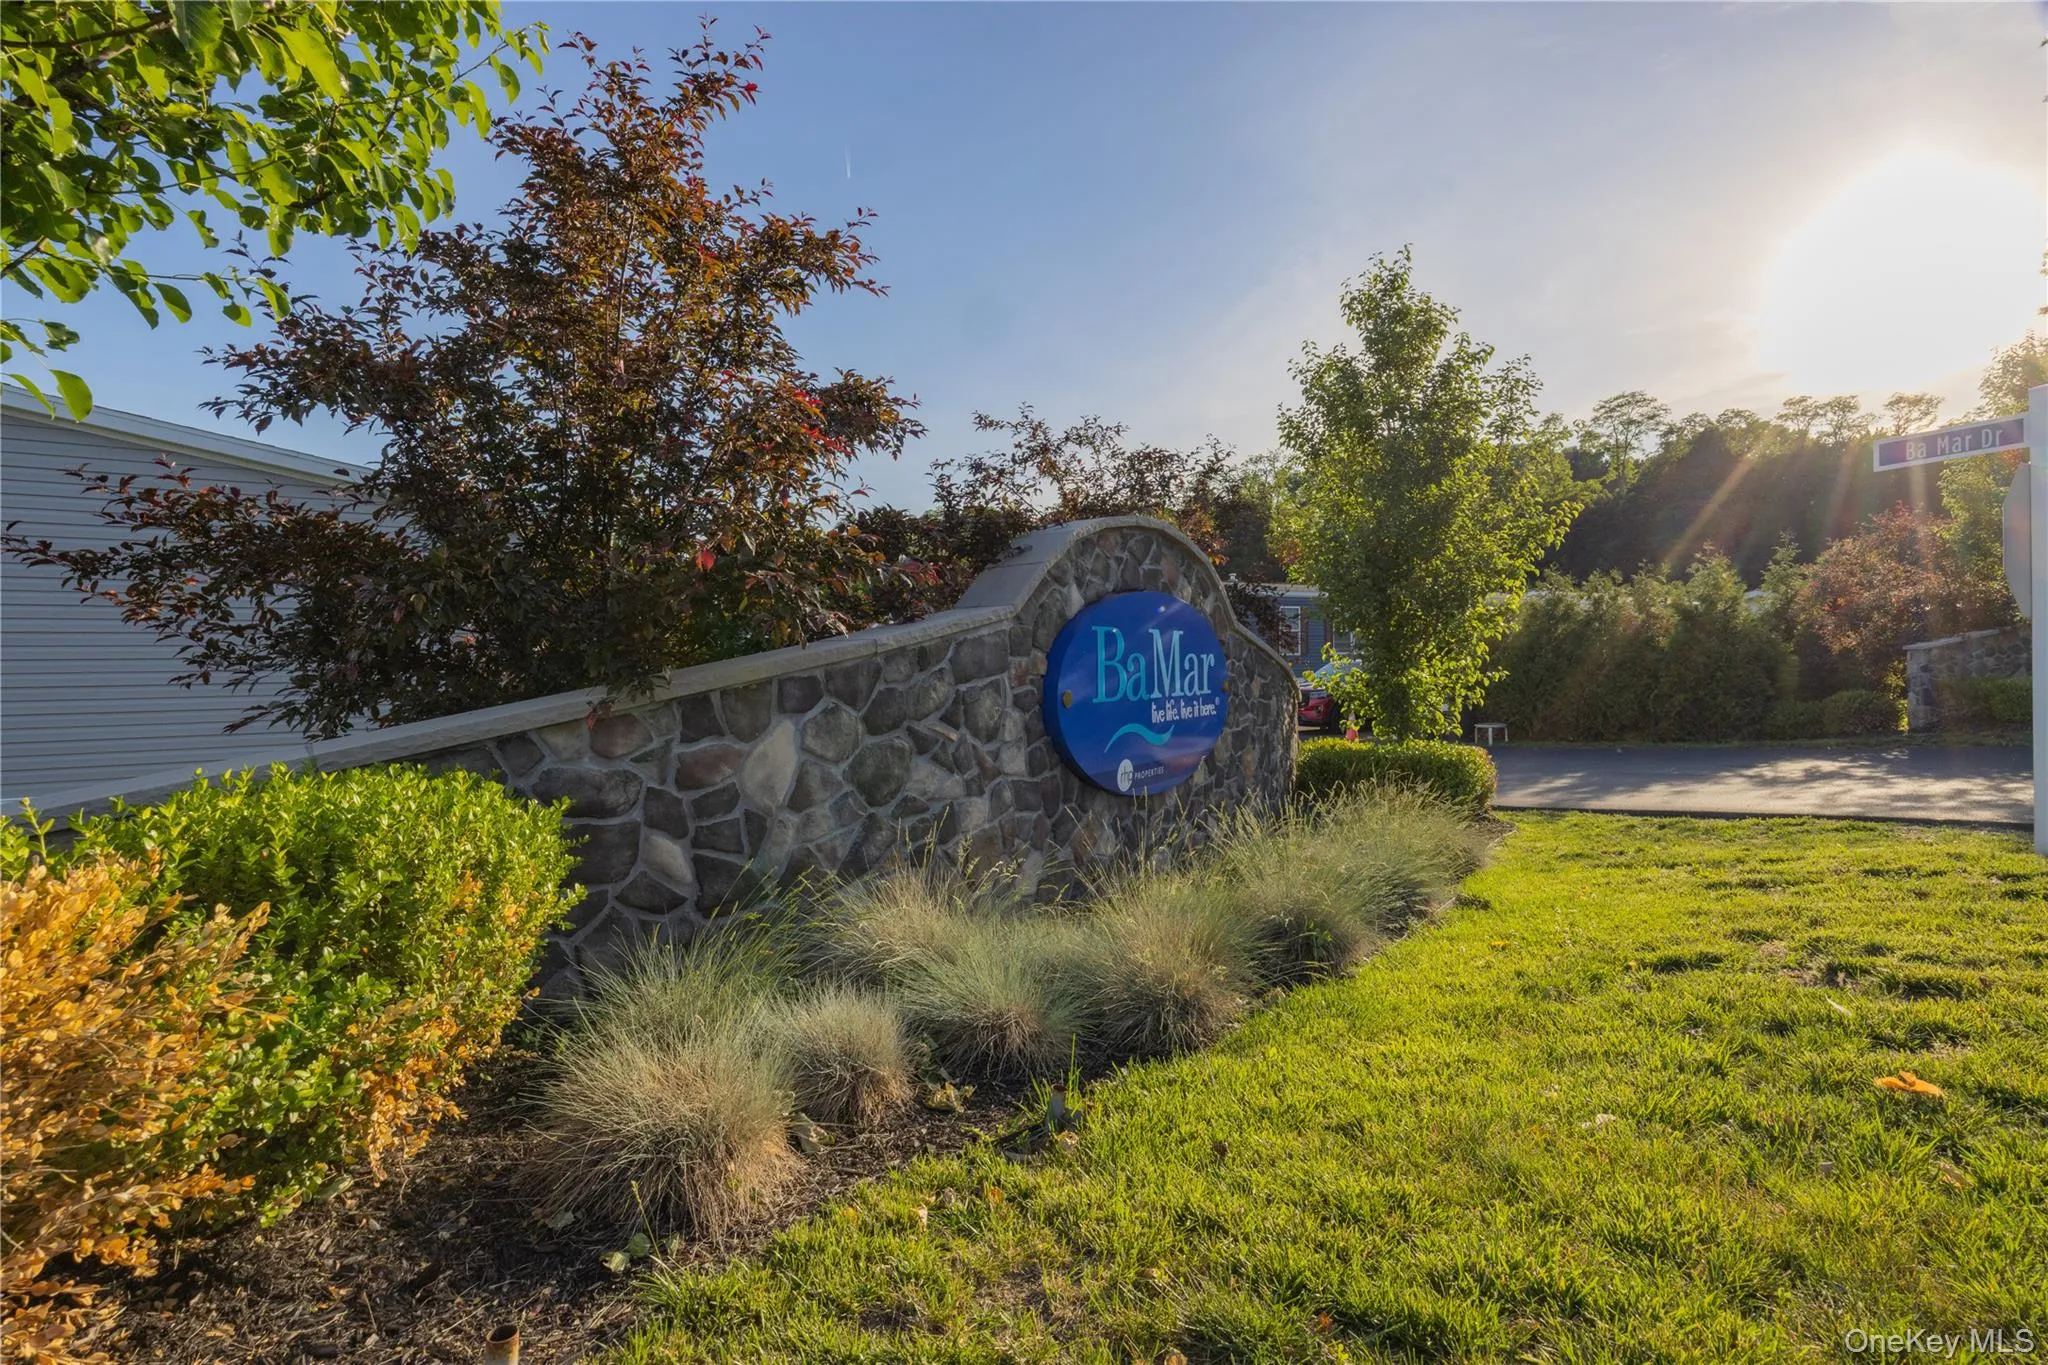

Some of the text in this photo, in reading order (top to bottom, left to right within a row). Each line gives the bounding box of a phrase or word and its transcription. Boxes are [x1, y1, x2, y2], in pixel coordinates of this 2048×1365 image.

[1905, 428, 2003, 460] Ba Mar Dr
[1151, 701, 1165, 723] live
[1180, 698, 1193, 720] live
